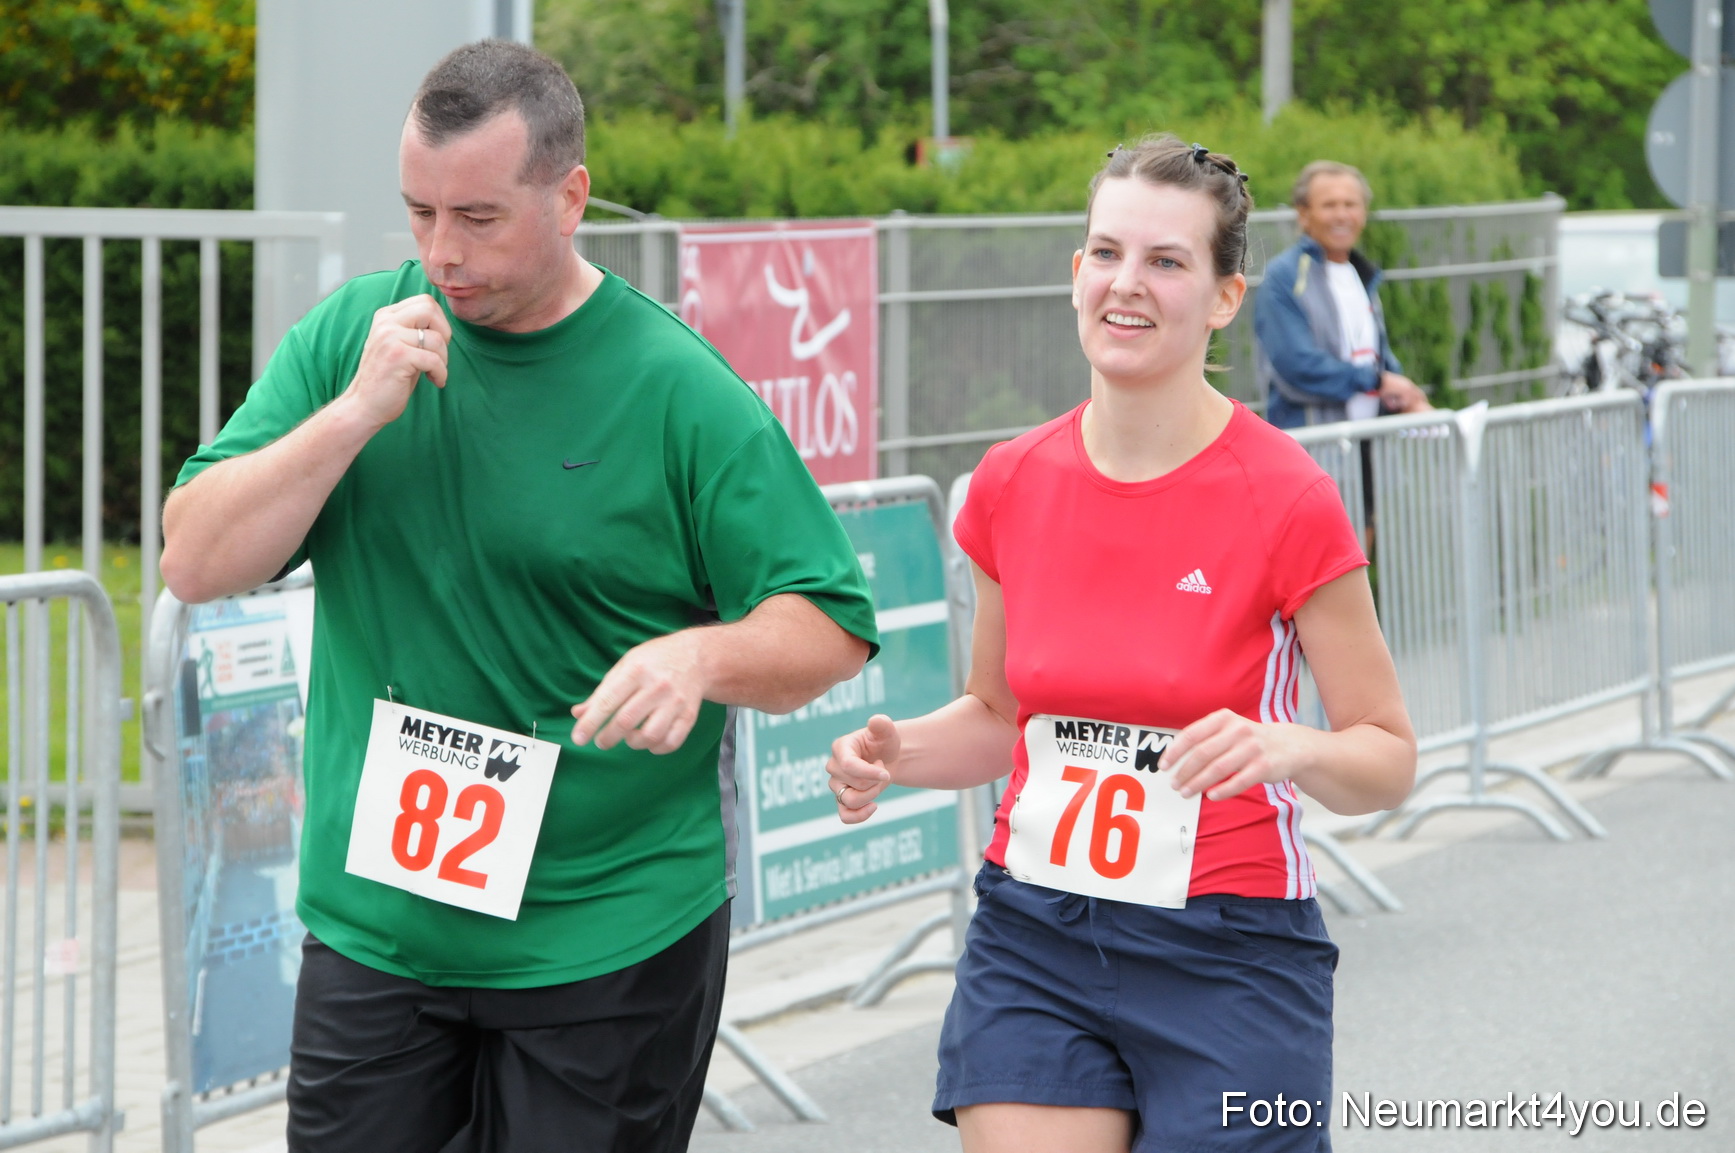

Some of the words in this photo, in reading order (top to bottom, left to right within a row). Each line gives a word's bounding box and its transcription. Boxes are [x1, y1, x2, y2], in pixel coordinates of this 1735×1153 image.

[1176, 582, 1212, 595] adidas
[399, 715, 484, 755] MEYER
[1055, 721, 1131, 748] MEYER
[1056, 740, 1129, 763] WERBUNG
[398, 736, 479, 770] WERBUNG
[391, 769, 506, 890] 82
[1050, 765, 1146, 880] 76
